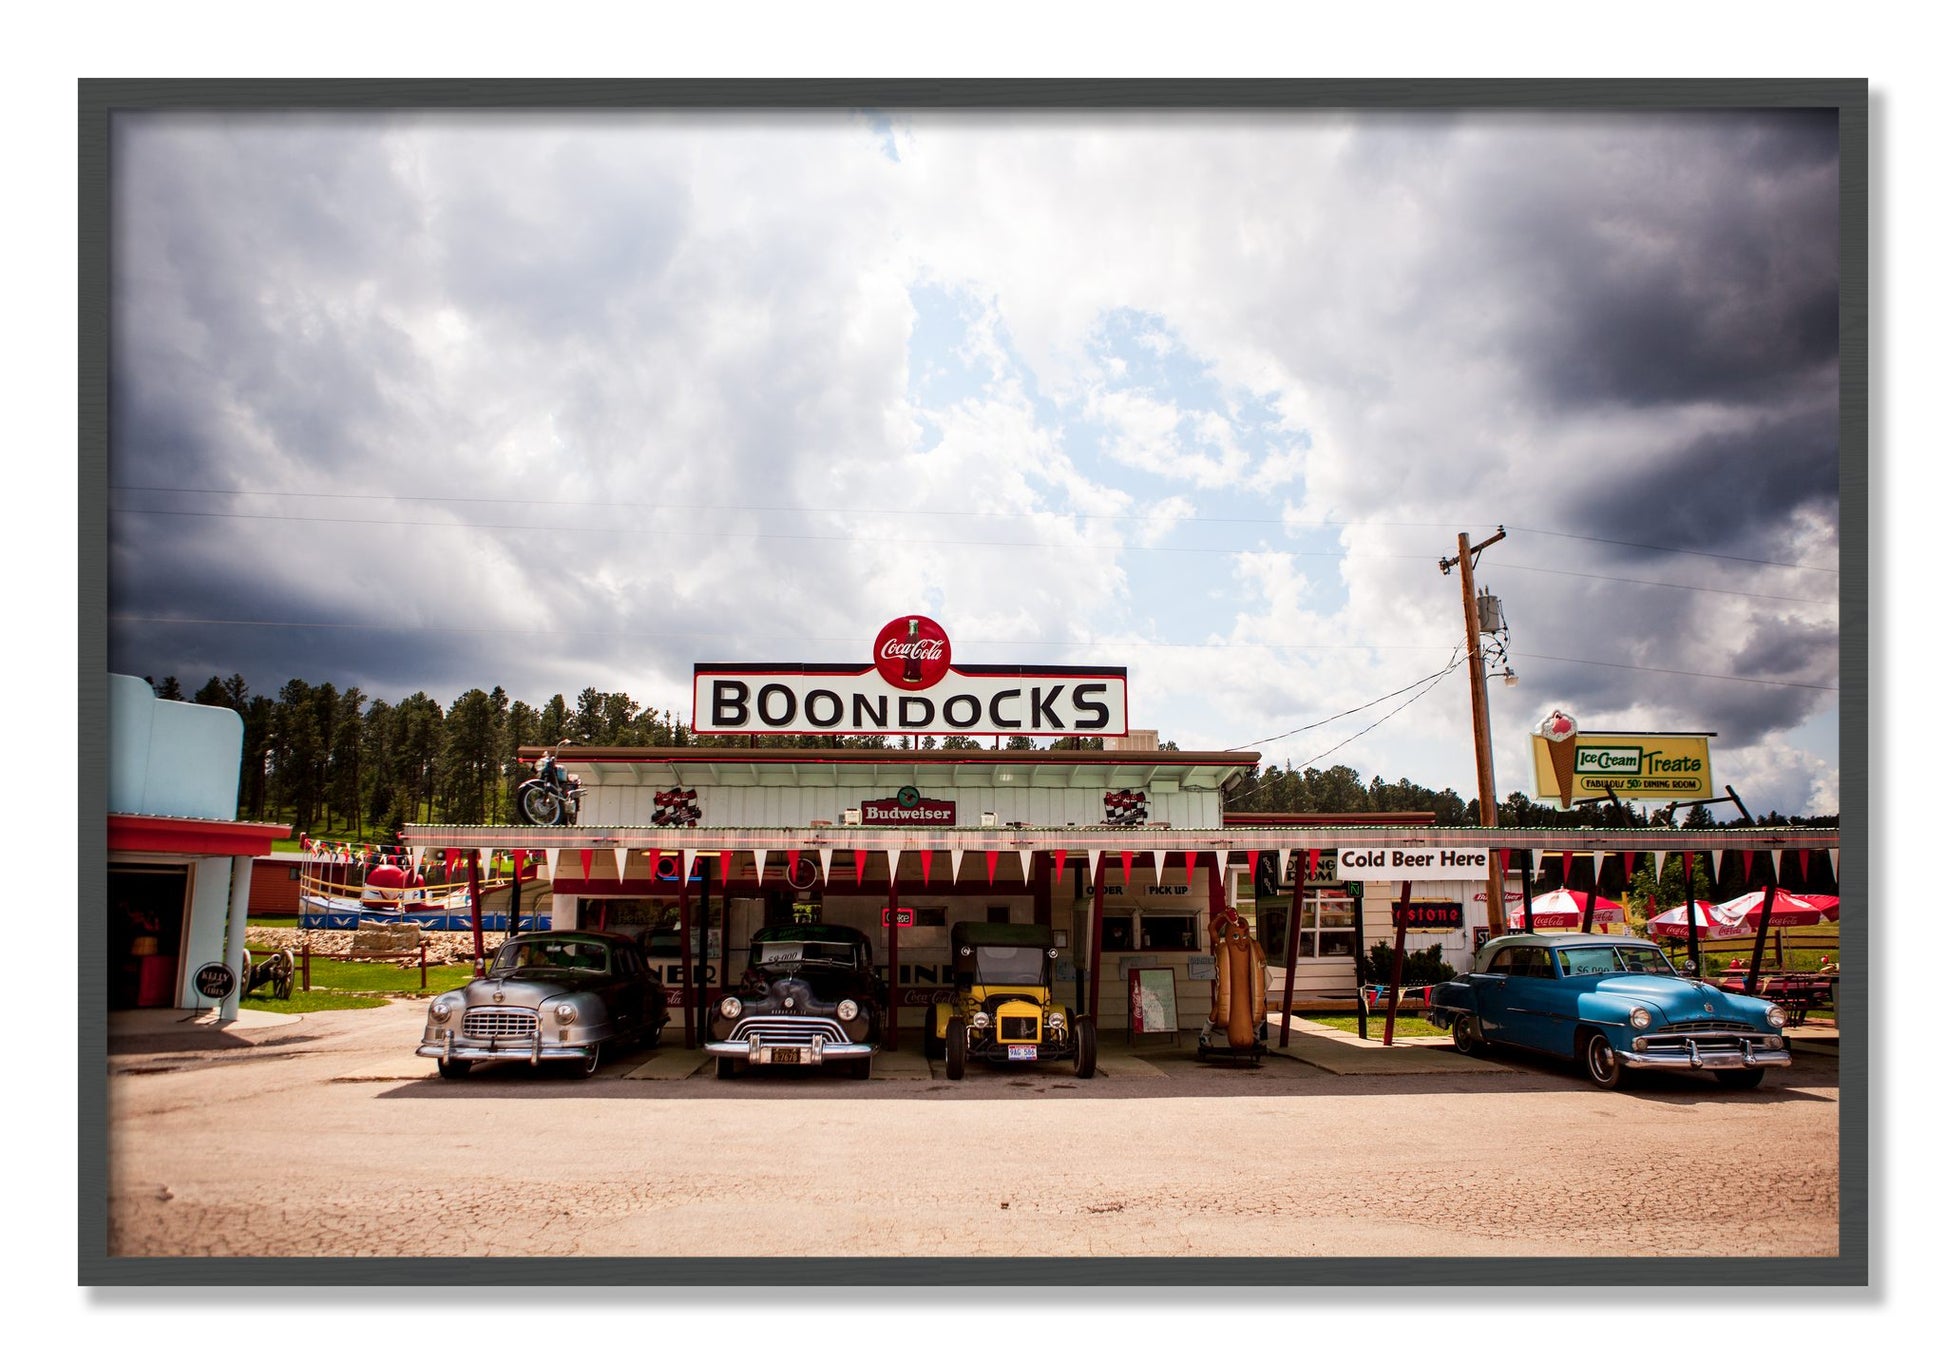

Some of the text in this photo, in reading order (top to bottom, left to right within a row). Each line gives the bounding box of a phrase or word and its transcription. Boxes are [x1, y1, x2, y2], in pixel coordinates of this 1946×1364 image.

[881, 638, 945, 661] Coca-Cola
[711, 680, 1110, 729] BOONDOCKS
[1580, 751, 1702, 775] Ice Cream Treats
[1586, 779, 1625, 788] FABULOUS
[1643, 779, 1670, 788] DINING
[1672, 780, 1696, 788] ROOM
[865, 806, 951, 819] Budweiser
[1341, 851, 1486, 867] Cold Beer Here
[1086, 886, 1123, 895] ODER
[1149, 886, 1188, 895] PICK UP
